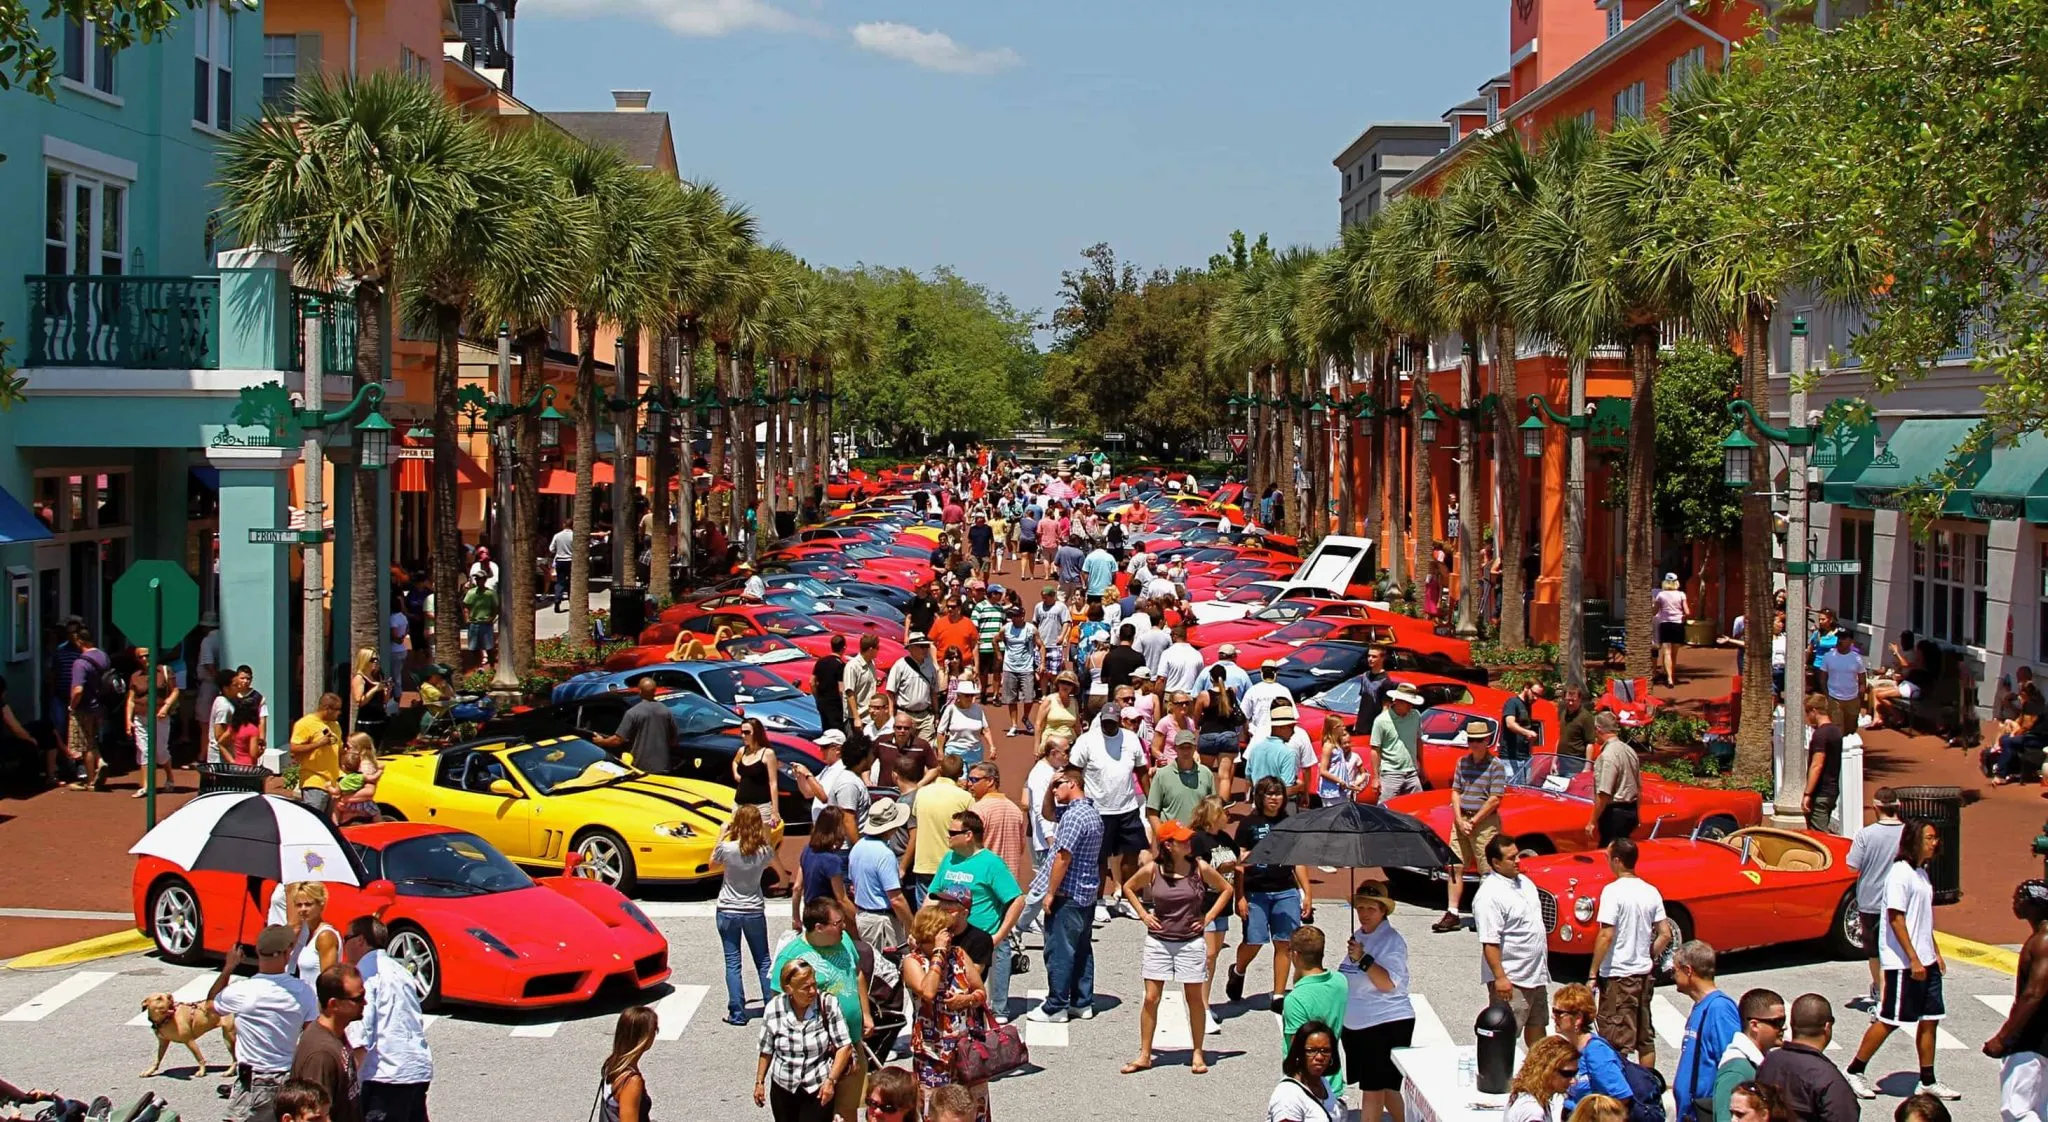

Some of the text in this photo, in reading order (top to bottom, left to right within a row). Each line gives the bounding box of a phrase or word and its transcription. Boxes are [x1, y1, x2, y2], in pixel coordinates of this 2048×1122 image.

[401, 449, 418, 457] PPER
[256, 530, 283, 542] FRONT
[1818, 562, 1845, 573] FRONT
